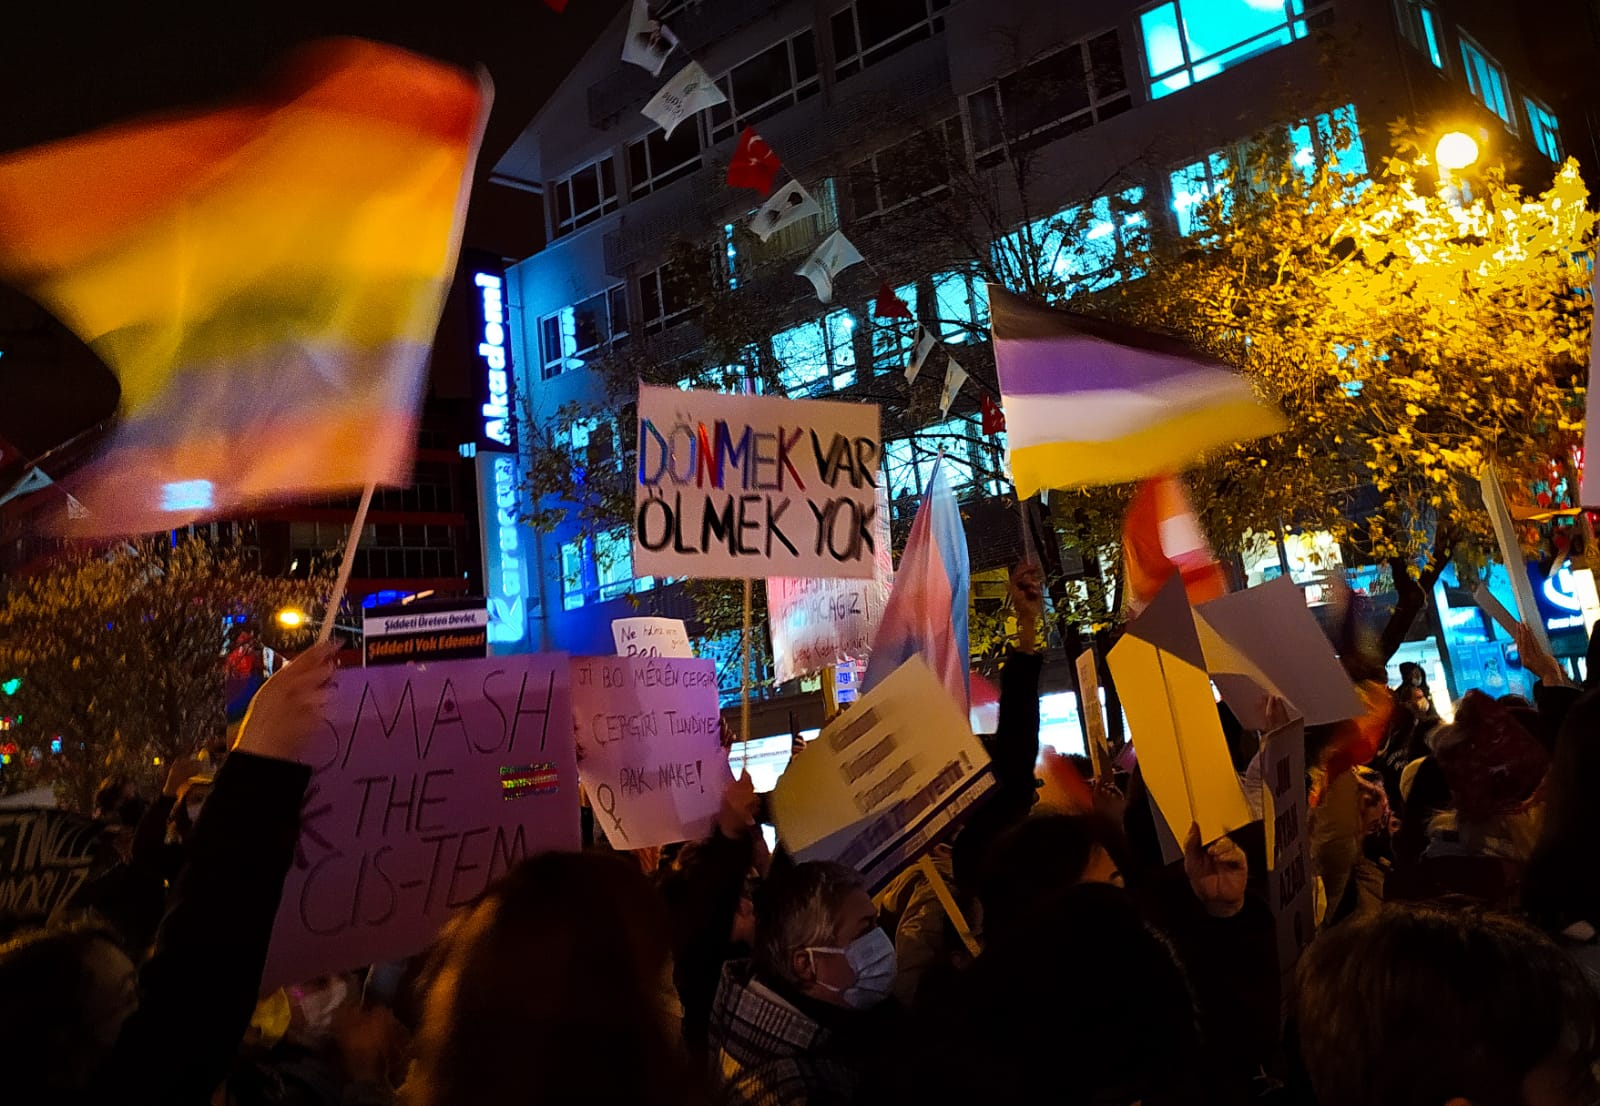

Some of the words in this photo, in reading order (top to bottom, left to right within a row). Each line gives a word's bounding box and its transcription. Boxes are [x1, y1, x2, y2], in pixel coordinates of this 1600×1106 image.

[474, 272, 511, 446] Akademi
[638, 408, 806, 492] DÖNMEK
[810, 427, 879, 489] VAR
[637, 487, 800, 559] ÖLMEK
[807, 496, 876, 562] YOK
[368, 639, 414, 659] Şiddeti
[415, 637, 438, 653] Yok
[438, 631, 485, 651] Edemez!
[384, 618, 418, 632] Şiddeti
[621, 626, 637, 643] Ne
[353, 769, 454, 837] THE
[620, 767, 653, 797] PAK
